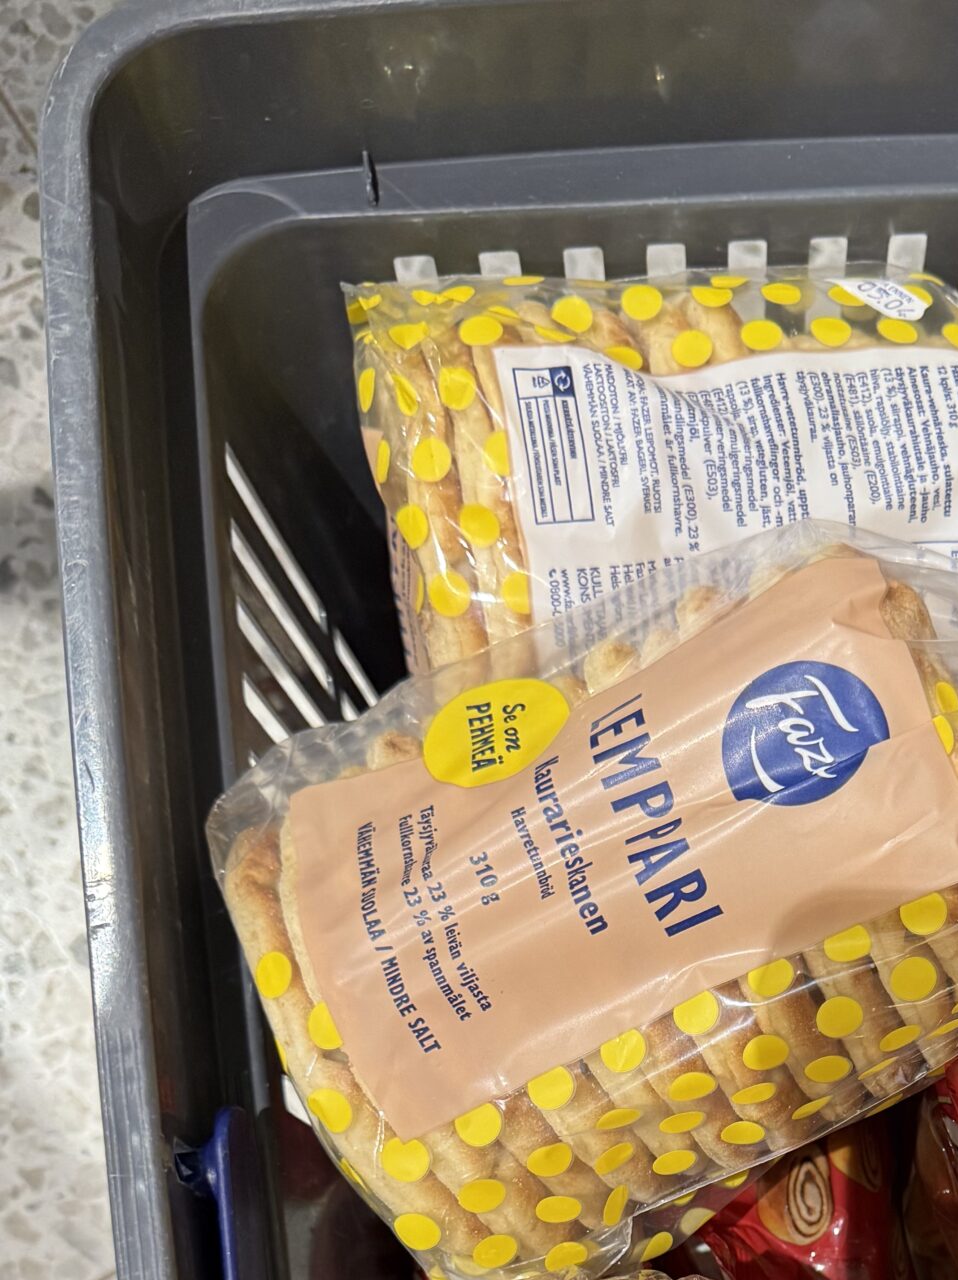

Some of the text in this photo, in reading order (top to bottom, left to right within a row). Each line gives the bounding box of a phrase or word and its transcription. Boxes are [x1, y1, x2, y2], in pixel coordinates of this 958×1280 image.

[735, 380, 749, 396] (13
[880, 367, 894, 383] (13
[639, 396, 651, 424] FAZER
[817, 406, 827, 419] 23
[833, 372, 853, 431] nostatusaine
[946, 404, 958, 420] 310
[630, 408, 642, 438] FAZER
[763, 374, 786, 437] Ingredienser:
[781, 440, 796, 497] Vetemjöl,
[821, 422, 830, 432] %
[907, 366, 926, 417] Ainesosat:
[921, 419, 940, 485] Vehnäjauho,
[665, 438, 674, 452] är
[822, 435, 835, 470] viljasta
[599, 465, 611, 503] MINDRE
[829, 472, 837, 486] on
[872, 439, 893, 510] emulgointiaine
[886, 441, 905, 511] stabilointiaine
[916, 474, 928, 484] ja
[943, 464, 952, 517] sulatettu
[667, 455, 683, 537] fullkornshavre.
[773, 486, 783, 507] och
[603, 505, 615, 526] SALT
[687, 526, 697, 539] 23
[689, 541, 698, 551] %
[463, 697, 506, 773] PEHMEÄ
[500, 696, 523, 755] Se on
[586, 692, 724, 936] LEMPPARI
[355, 819, 379, 889] VÄHEMMÄN
[510, 805, 556, 900] Havretunnbröd
[535, 755, 611, 936] Kaurarieskanen
[401, 884, 424, 910] 23
[425, 881, 448, 905] 23
[468, 849, 502, 907] 310 g
[360, 885, 387, 941] SUOLAA
[411, 907, 432, 928] %
[436, 903, 456, 922] %
[419, 928, 434, 946] av
[441, 921, 468, 960] leivän
[380, 956, 419, 1019] MINDRE
[419, 944, 473, 1022] spannmålet
[454, 959, 495, 1012] viljasta
[405, 1016, 441, 1055] SALT
